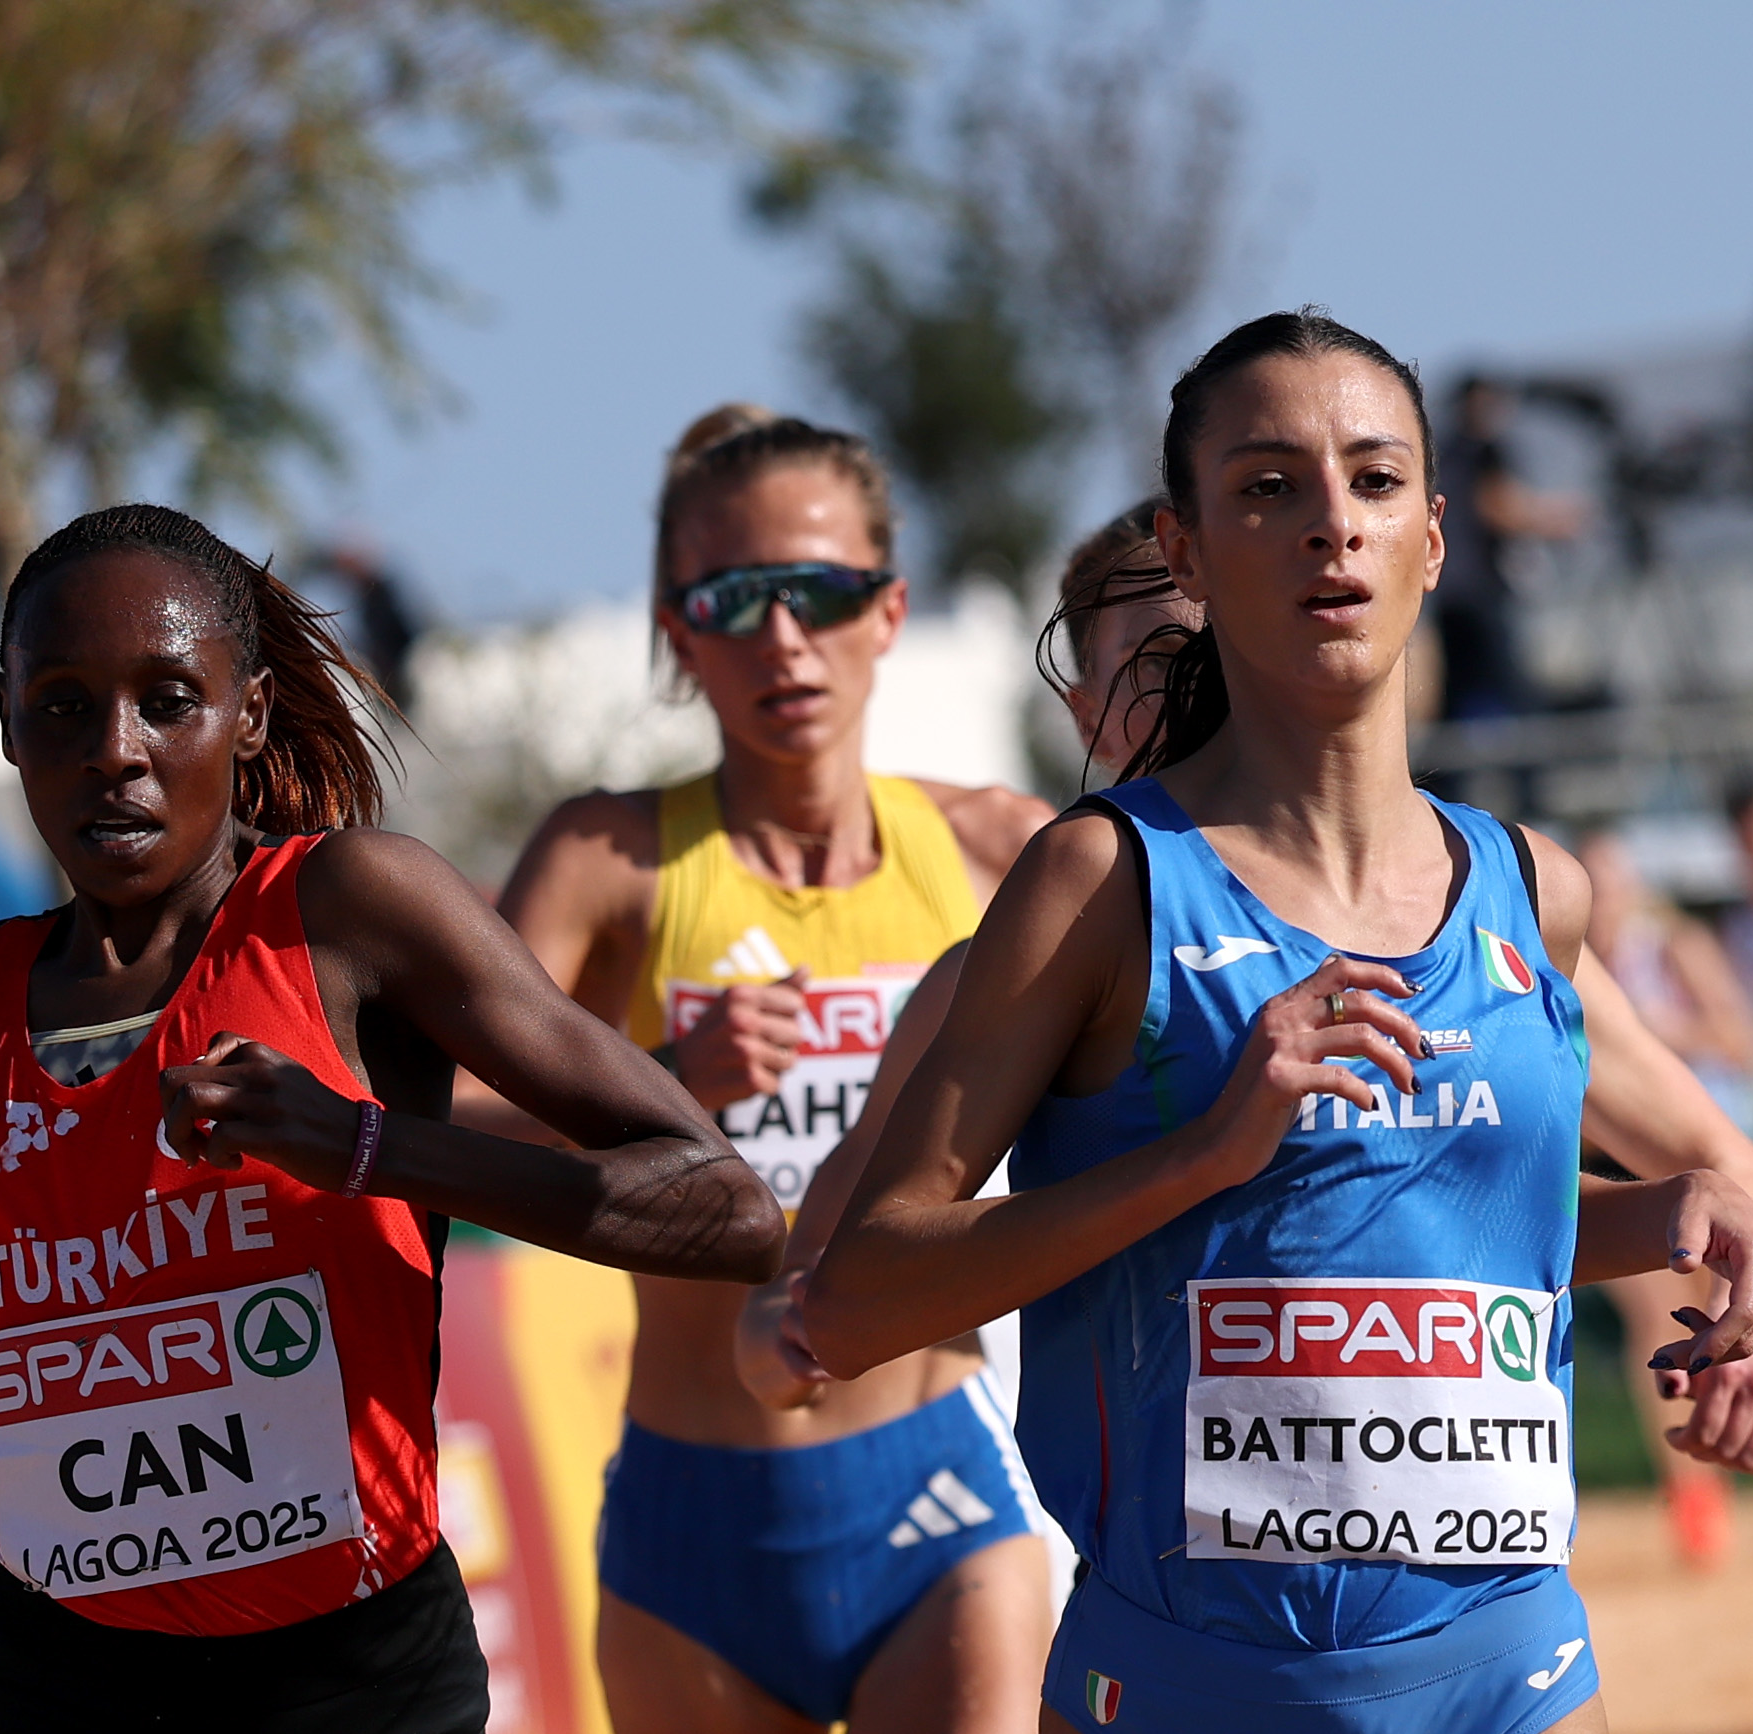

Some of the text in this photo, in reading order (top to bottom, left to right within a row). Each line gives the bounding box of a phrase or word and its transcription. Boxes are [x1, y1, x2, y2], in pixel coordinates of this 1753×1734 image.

[1301, 1080, 1501, 1131] ITALIA
[1208, 1301, 1478, 1364] SPAR
[58, 1413, 254, 1513] CAN
[1203, 1417, 1557, 1463] BATTOCLETTI
[201, 1493, 328, 1565] 2025
[1222, 1509, 1548, 1554] LAGOA 2025
